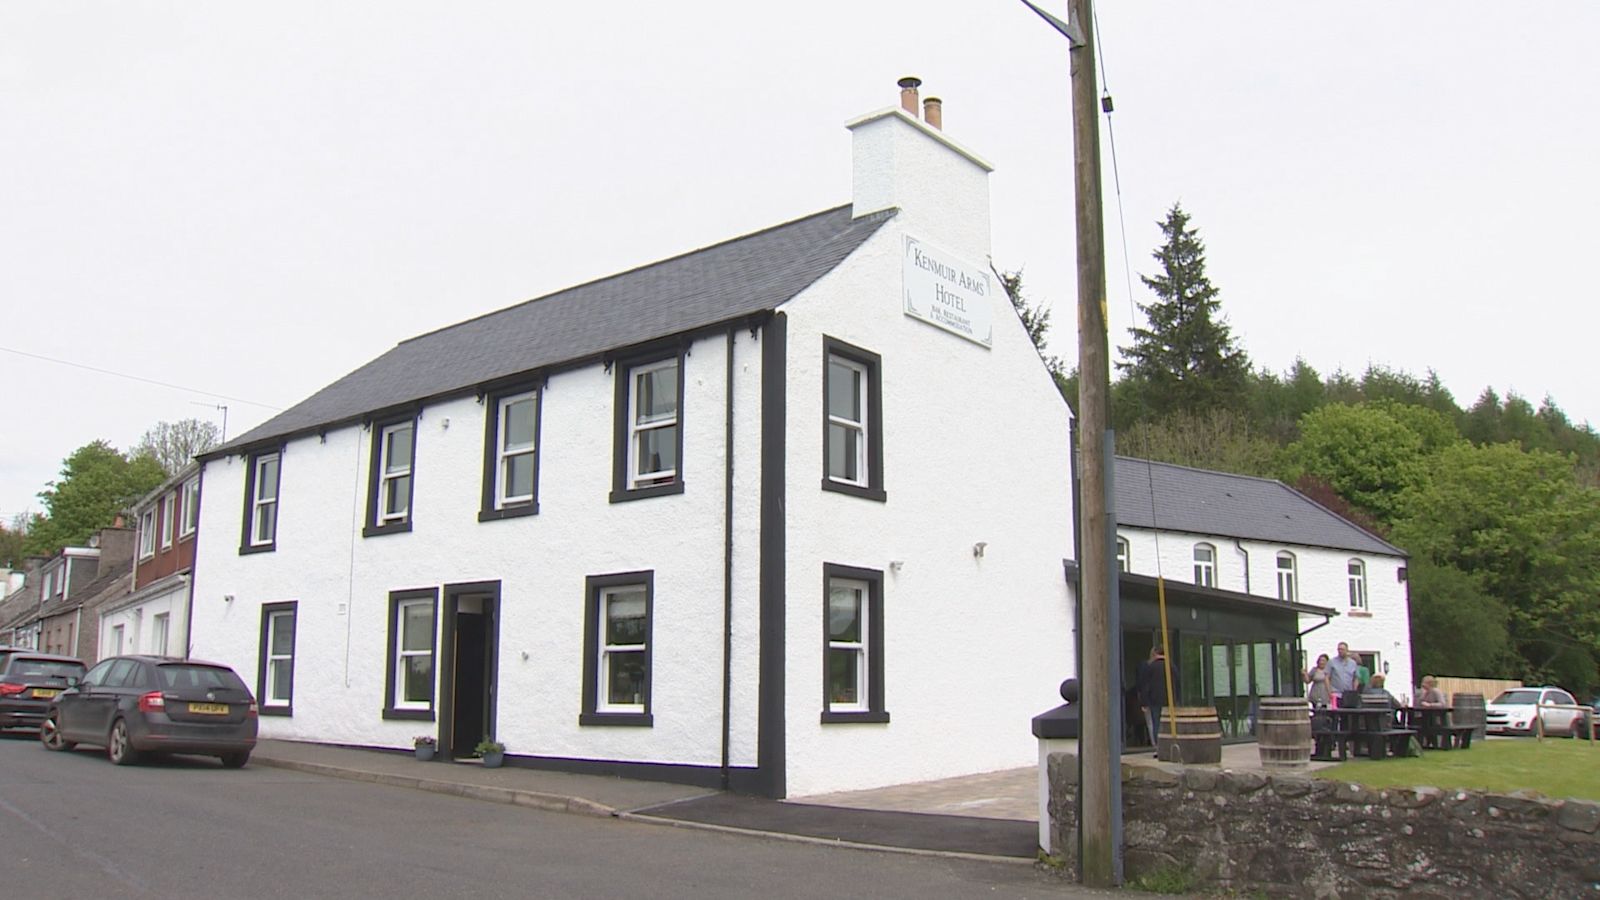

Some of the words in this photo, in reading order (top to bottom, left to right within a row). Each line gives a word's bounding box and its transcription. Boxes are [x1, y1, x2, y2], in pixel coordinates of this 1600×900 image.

[915, 248, 957, 283] KENMUIR
[959, 272, 984, 296] ARMS
[936, 283, 966, 312] HOTEL
